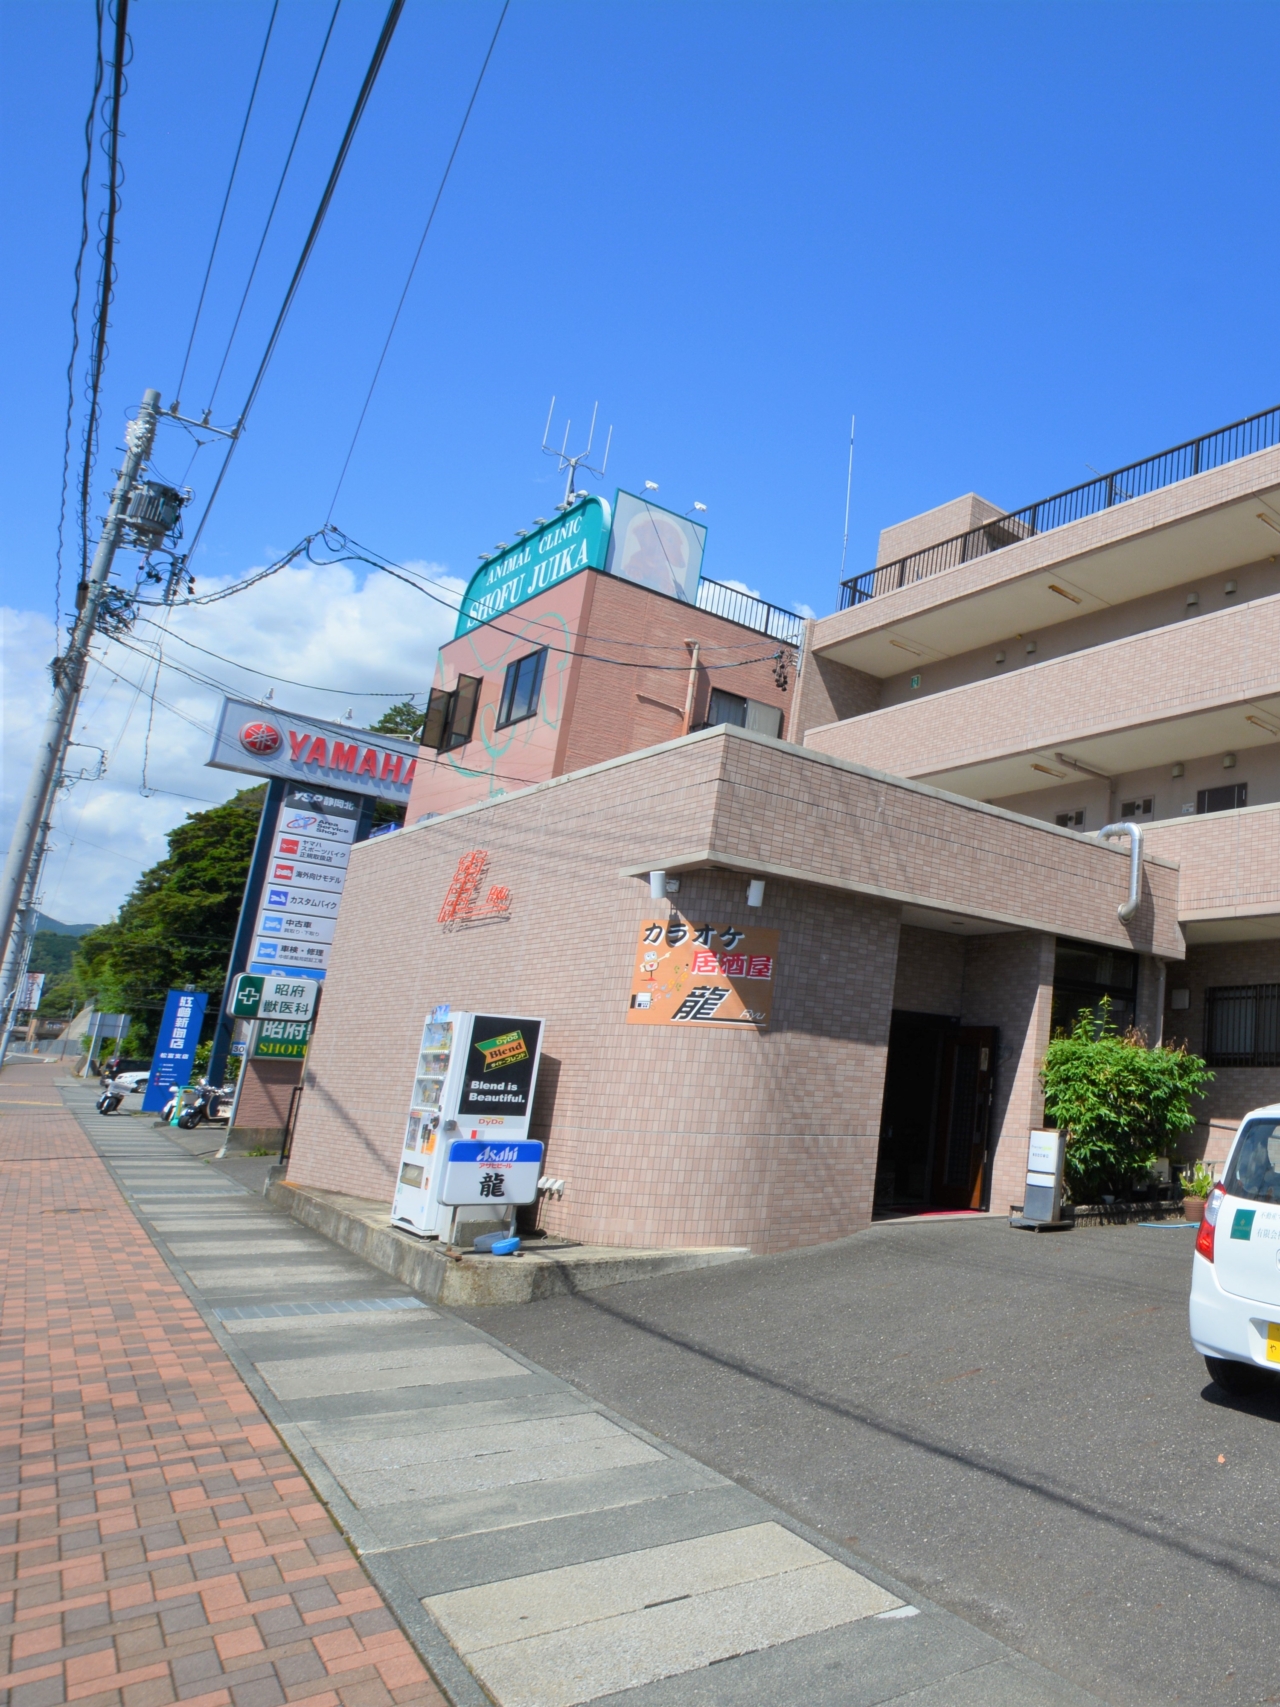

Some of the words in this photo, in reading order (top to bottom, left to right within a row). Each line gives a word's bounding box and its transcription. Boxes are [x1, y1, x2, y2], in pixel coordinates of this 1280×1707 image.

[486, 547, 531, 586] ANIMAL
[539, 516, 583, 554] CLINIC
[467, 573, 526, 629] SHOFU
[527, 538, 588, 594] JUIKA
[317, 823, 349, 833] Service
[318, 819, 339, 827] Area
[316, 828, 337, 836] Shop
[302, 840, 322, 848] ヤマハ
[301, 846, 346, 858] スポーツバイク
[296, 871, 341, 884] 海外向けモデル
[290, 896, 337, 909] カスタムバイク
[286, 919, 312, 928] 中古車
[643, 923, 745, 950] カラオケ
[281, 945, 323, 956] 車検・修理
[691, 950, 773, 980] 居酒屋
[274, 984, 305, 997] 昭府
[263, 1000, 309, 1015] 獣医科
[739, 1009, 766, 1020] Ryu
[233, 1045, 245, 1053] 30
[489, 1042, 523, 1059] Blend
[471, 1080, 505, 1090] Blend
[507, 1082, 518, 1091] is
[469, 1092, 525, 1103] Beautiful.
[478, 1117, 504, 1126] DyDo
[476, 1146, 519, 1162] Asahi
[479, 1172, 505, 1198] 龍
